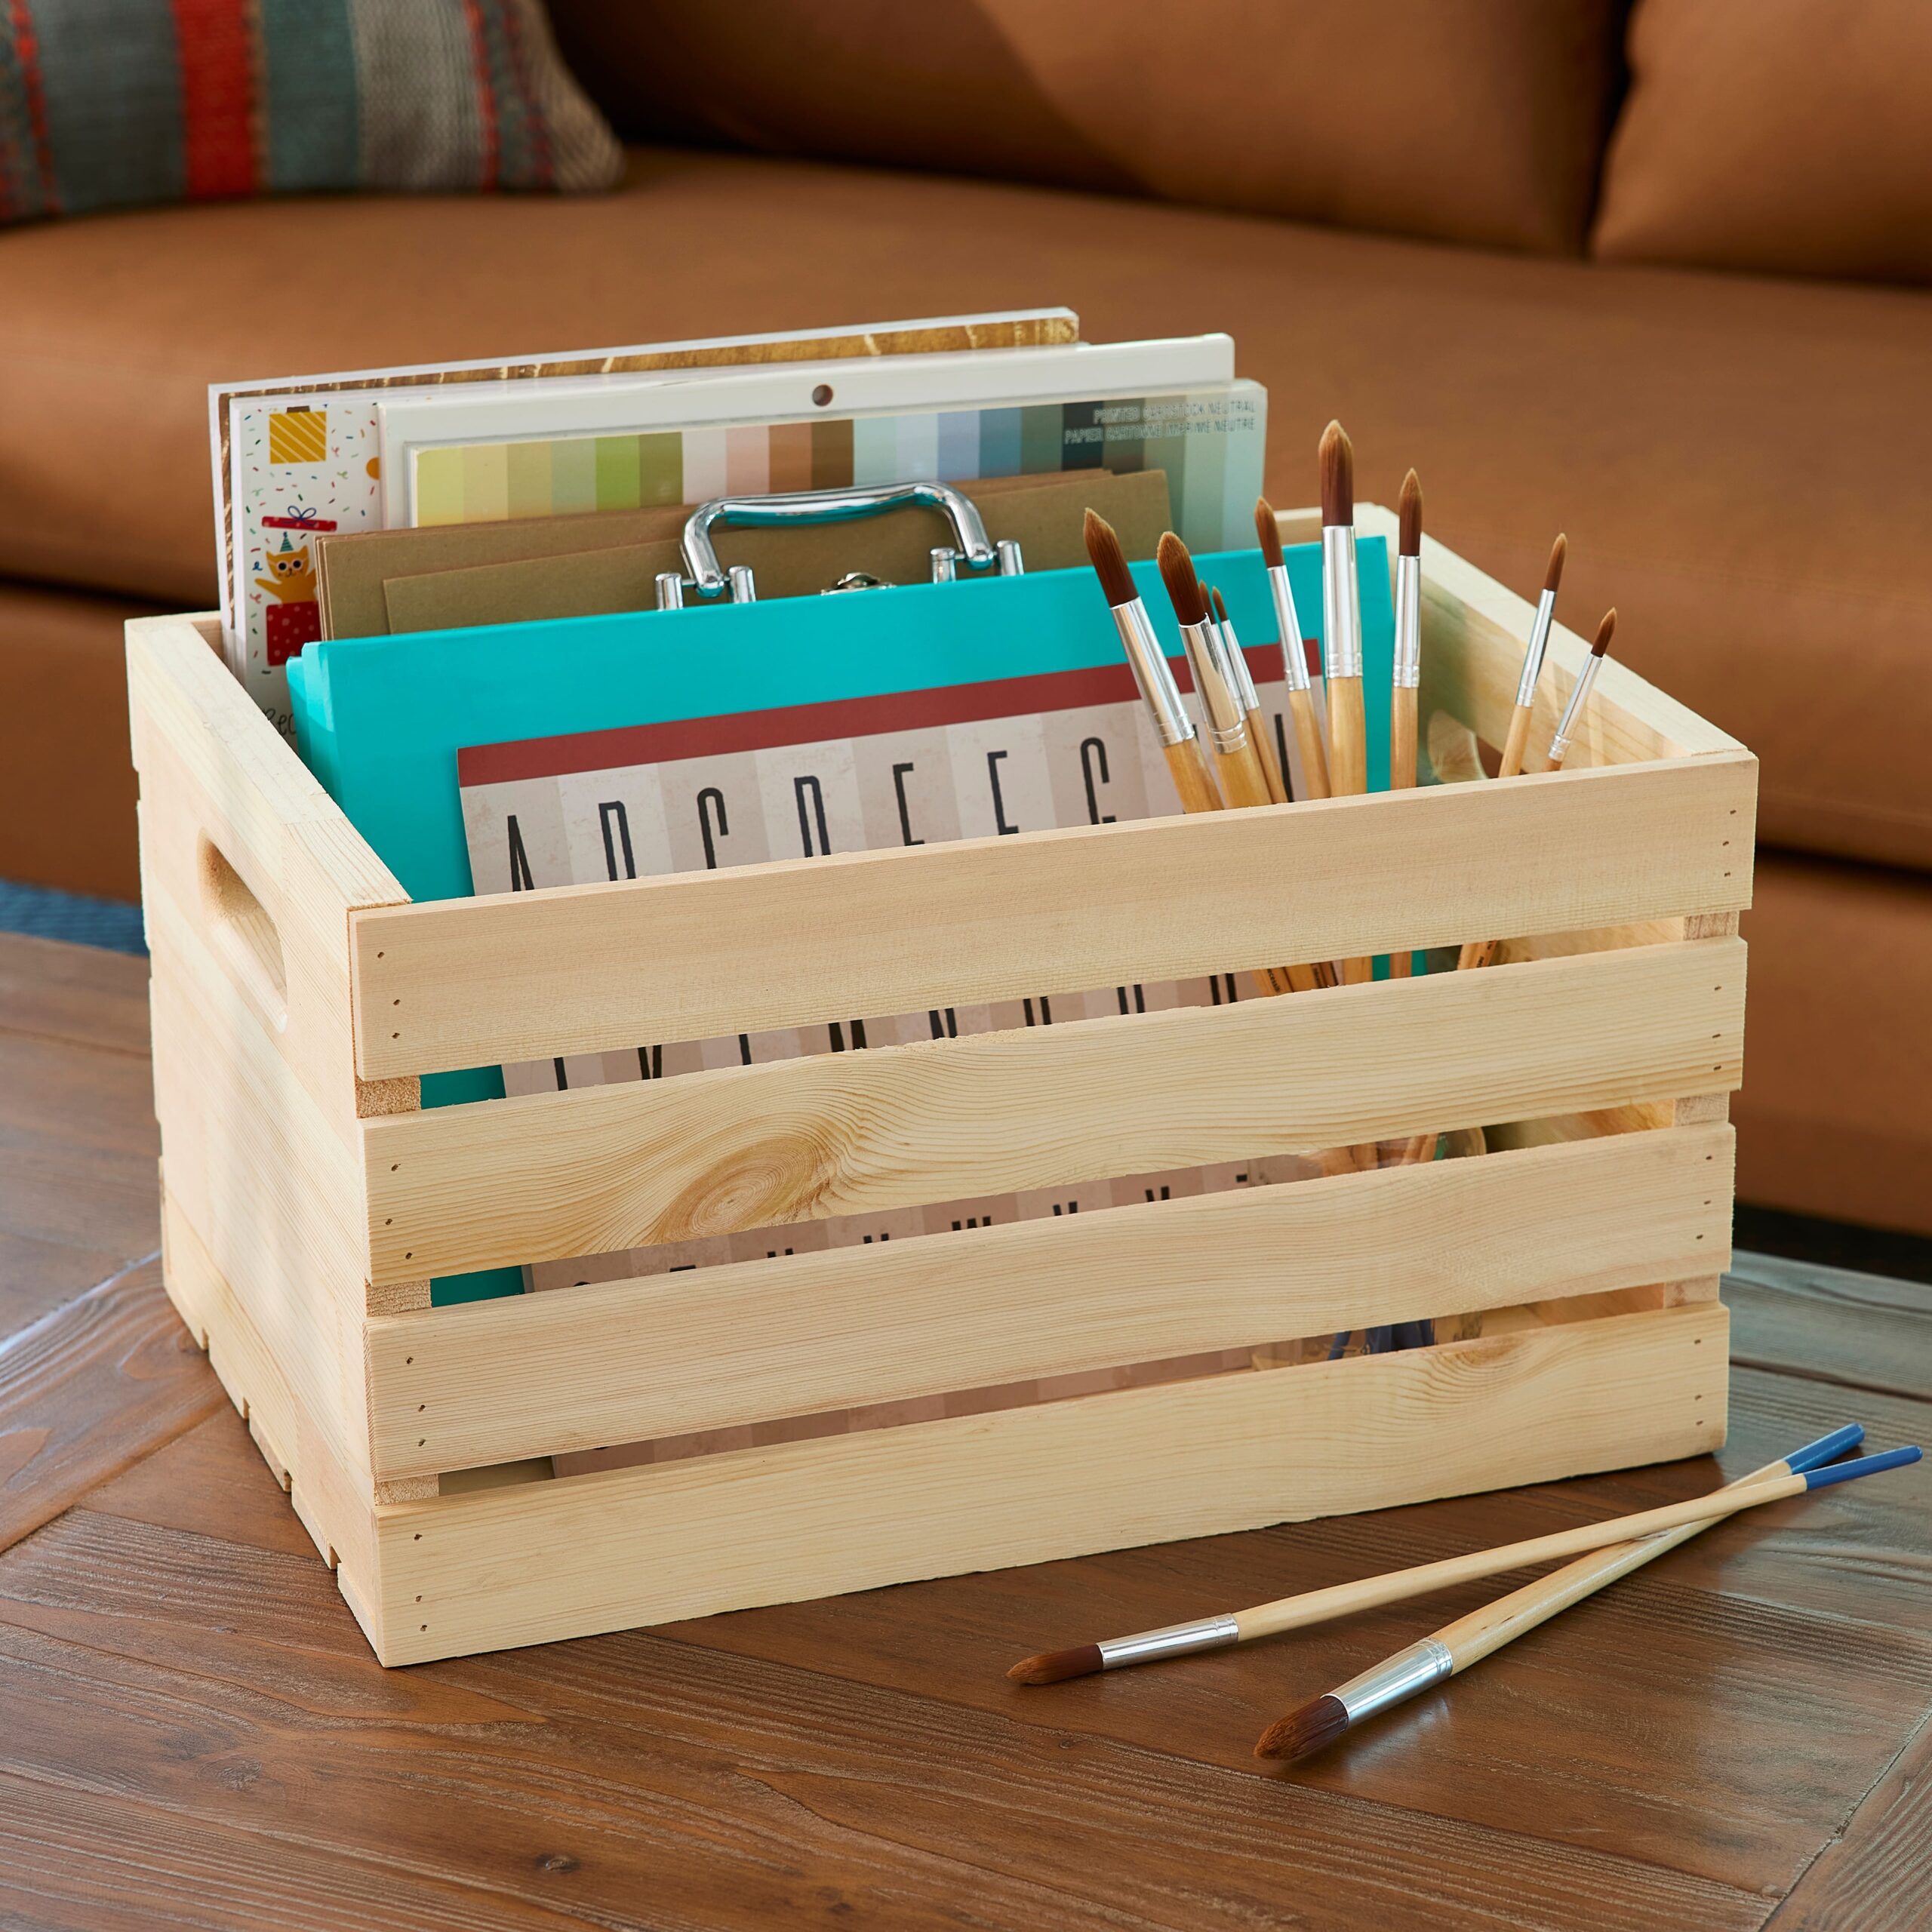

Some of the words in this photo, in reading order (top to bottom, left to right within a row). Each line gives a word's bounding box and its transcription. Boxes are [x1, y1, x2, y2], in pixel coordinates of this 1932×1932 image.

[1093, 406, 1140, 424] PRINTED
[1208, 398, 1256, 417] NEUTRAL
[1064, 427, 1103, 445] PAPIER
[1214, 417, 1256, 434] NEUTRE
